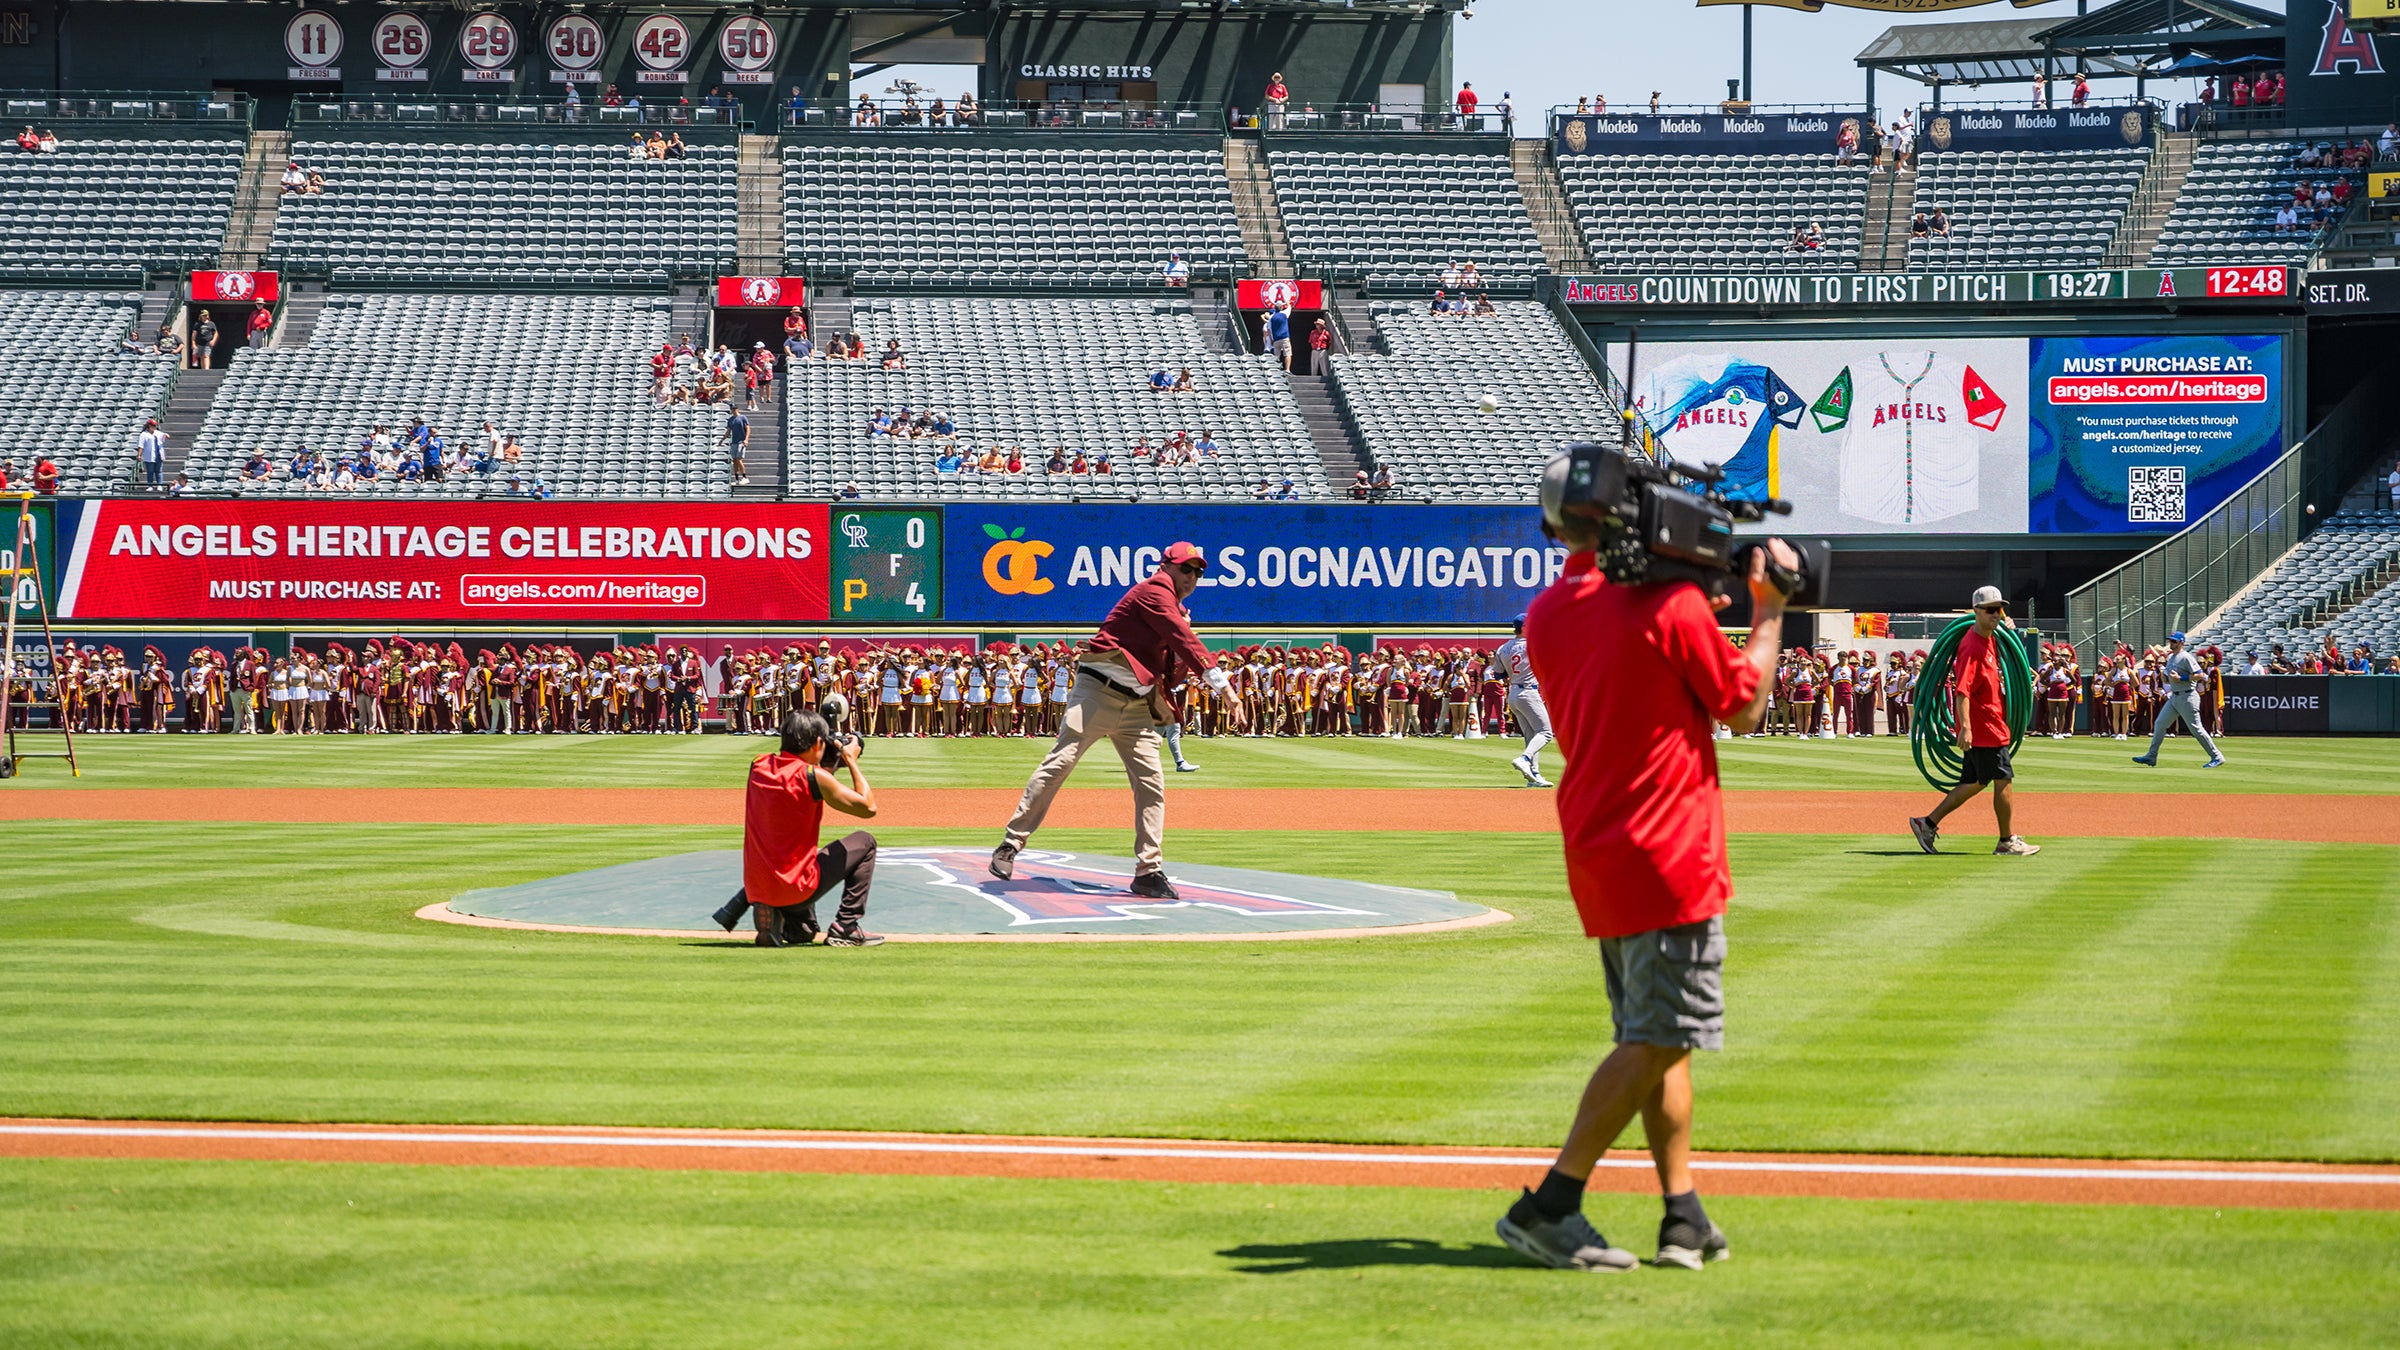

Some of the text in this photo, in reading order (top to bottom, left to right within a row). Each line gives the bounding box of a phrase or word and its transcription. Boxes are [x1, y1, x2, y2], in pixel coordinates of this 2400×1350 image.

[301, 24, 326, 54] 11
[382, 25, 423, 55] 26
[468, 26, 510, 56] 29
[555, 27, 596, 57] 30
[640, 28, 682, 58] 42
[727, 28, 768, 59] 50
[299, 69, 330, 77] FREGOSI
[391, 71, 414, 79] AUTRY
[476, 72, 500, 80] CAREW
[566, 72, 585, 80] RYAN
[644, 73, 680, 81] ROBINSON
[736, 74, 759, 82] REESE
[1021, 64, 1152, 78] CLASSIC HITS
[1597, 118, 1828, 134] Modelo Modelo Modelo Modelo
[1961, 112, 2110, 130] Modelo Modelo Modelo
[1566, 275, 2006, 304] ANGELS COUNTDOWN TO FIRST PITCH
[2048, 272, 2111, 298] 19:27
[2209, 268, 2283, 294] 12:48
[2310, 284, 2370, 303] SET. DR.
[2063, 356, 2253, 372] MUST PURCHASE AT:
[2054, 380, 2262, 401] angels.com/heritage
[1676, 406, 1748, 433] ANGELS
[1872, 402, 1946, 429] ANGELS
[2100, 417, 2124, 426] must
[2125, 415, 2167, 428] purchase
[2169, 415, 2199, 425] tickets
[2200, 415, 2239, 427] through
[2082, 430, 2233, 443] angels.com/heritage to receive
[2119, 444, 2172, 453] customized
[2172, 444, 2203, 455] jersey.
[109, 524, 812, 559] ANGELS HERITAGE CELEBRATIONS
[906, 517, 925, 549] 0
[890, 553, 903, 577] F
[1067, 546, 1570, 588] ANGLS.OCNAVIGATOR
[209, 580, 441, 599] MUST PURCHASE AT:
[467, 580, 699, 603] angels.com/heritage
[843, 578, 868, 612] P
[905, 582, 926, 613] 4
[1511, 653, 1522, 675] 2
[2224, 695, 2319, 709] FRIGIDAIRE
